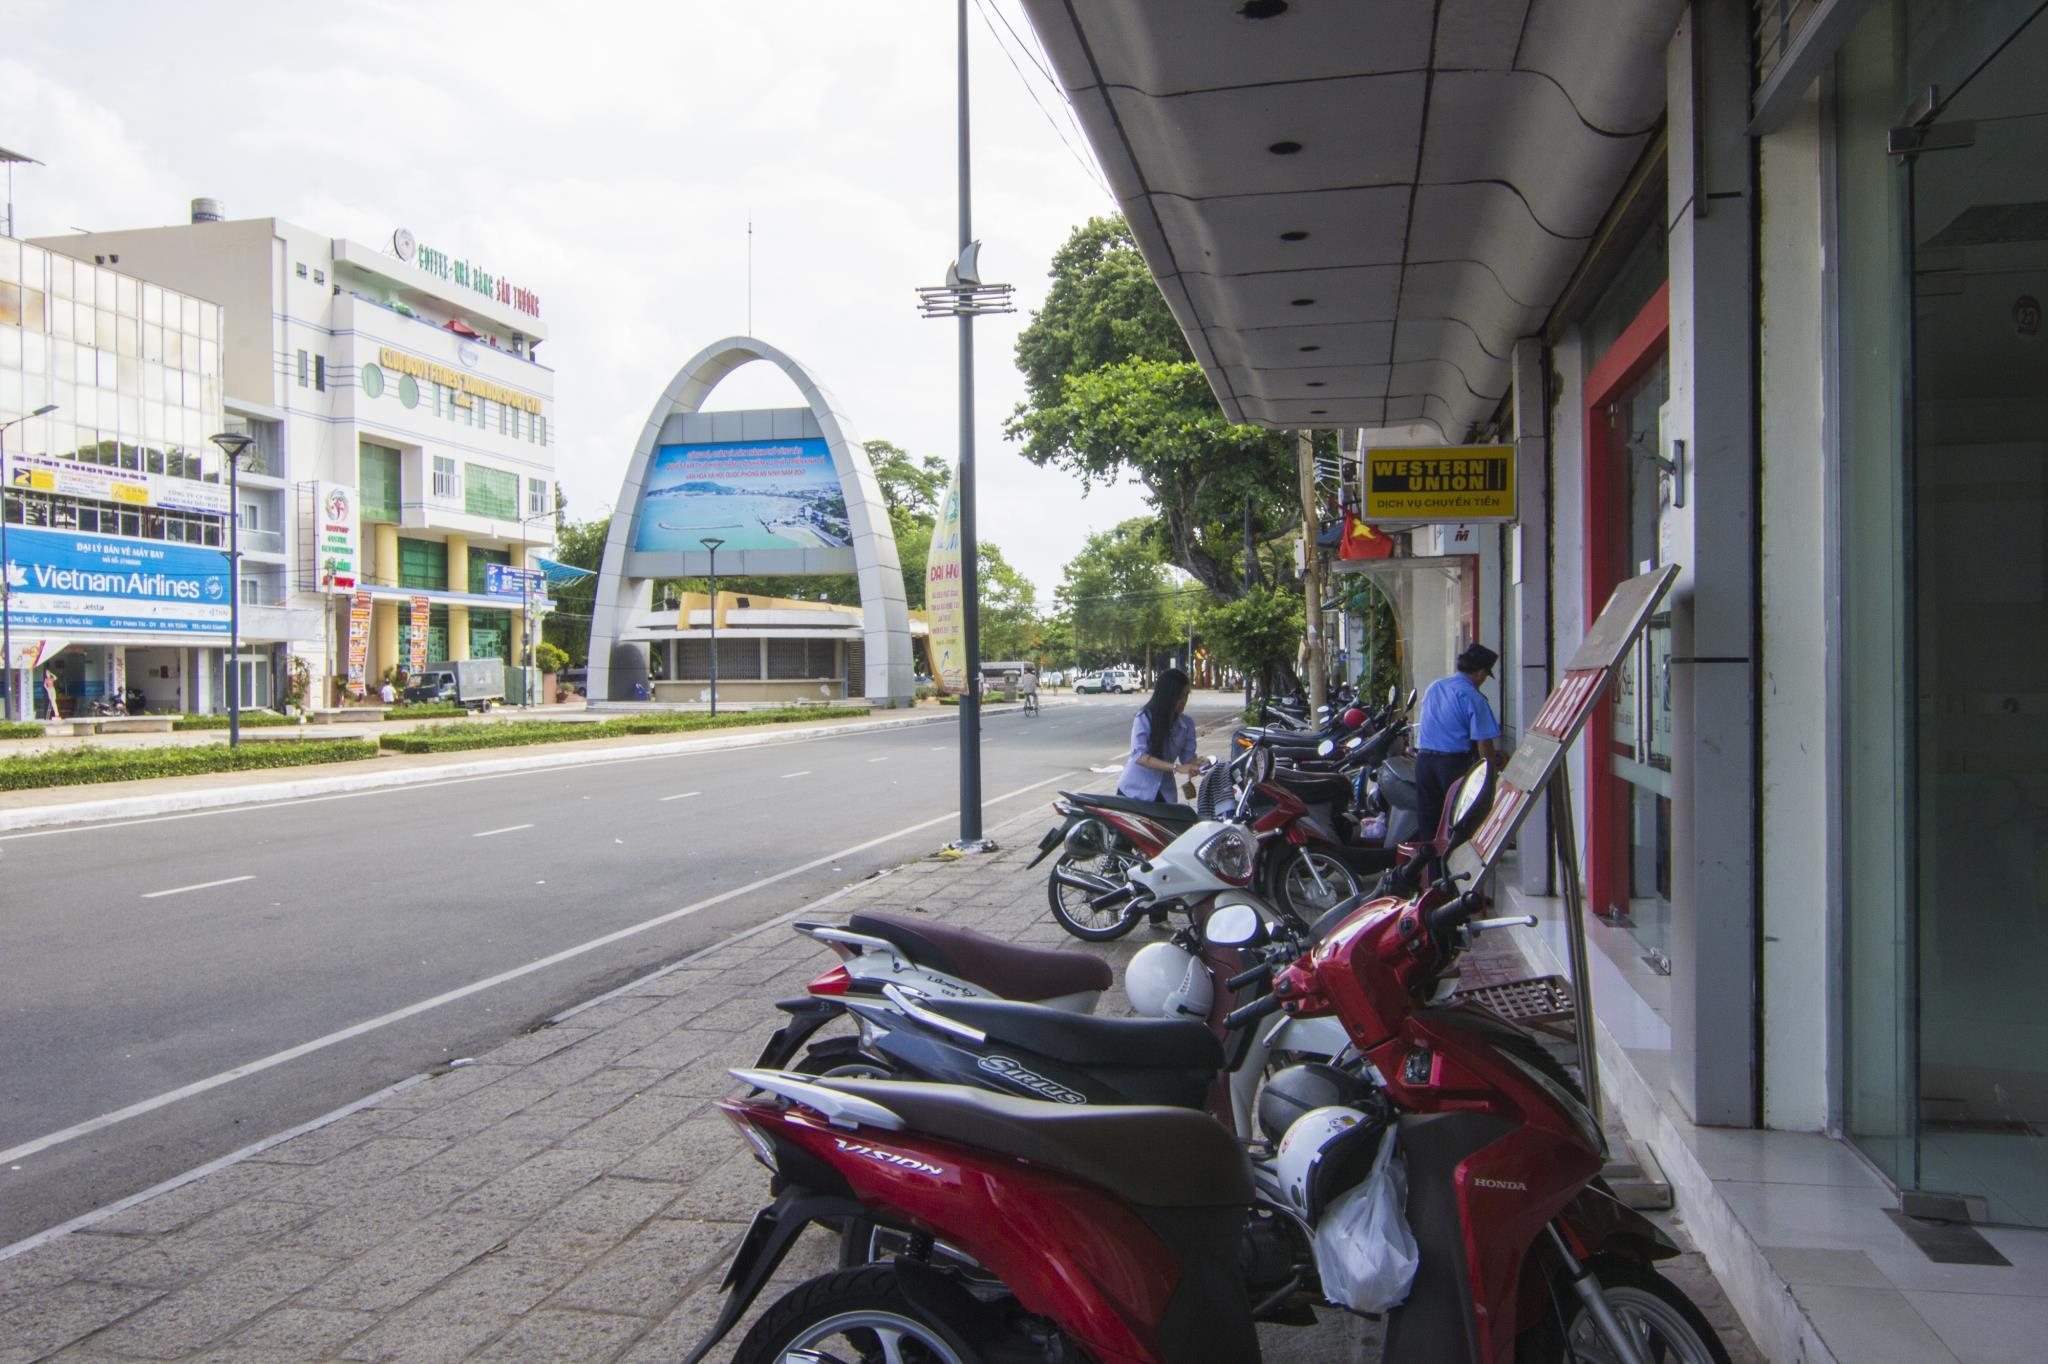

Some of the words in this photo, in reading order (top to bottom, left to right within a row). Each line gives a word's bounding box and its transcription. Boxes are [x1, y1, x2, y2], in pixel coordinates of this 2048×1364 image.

[1374, 461, 1484, 476] WESTERN
[1409, 476, 1484, 491] UNION
[1377, 498, 1404, 509] DỊCH
[1407, 498, 1422, 508] VỤ
[1424, 495, 1471, 507] CHUYỂN
[33, 563, 126, 593] Vietnam
[127, 572, 200, 598] Airlines
[927, 975, 977, 997] Liberty
[834, 1138, 944, 1175] VISION
[1473, 1177, 1529, 1192] HONDA
